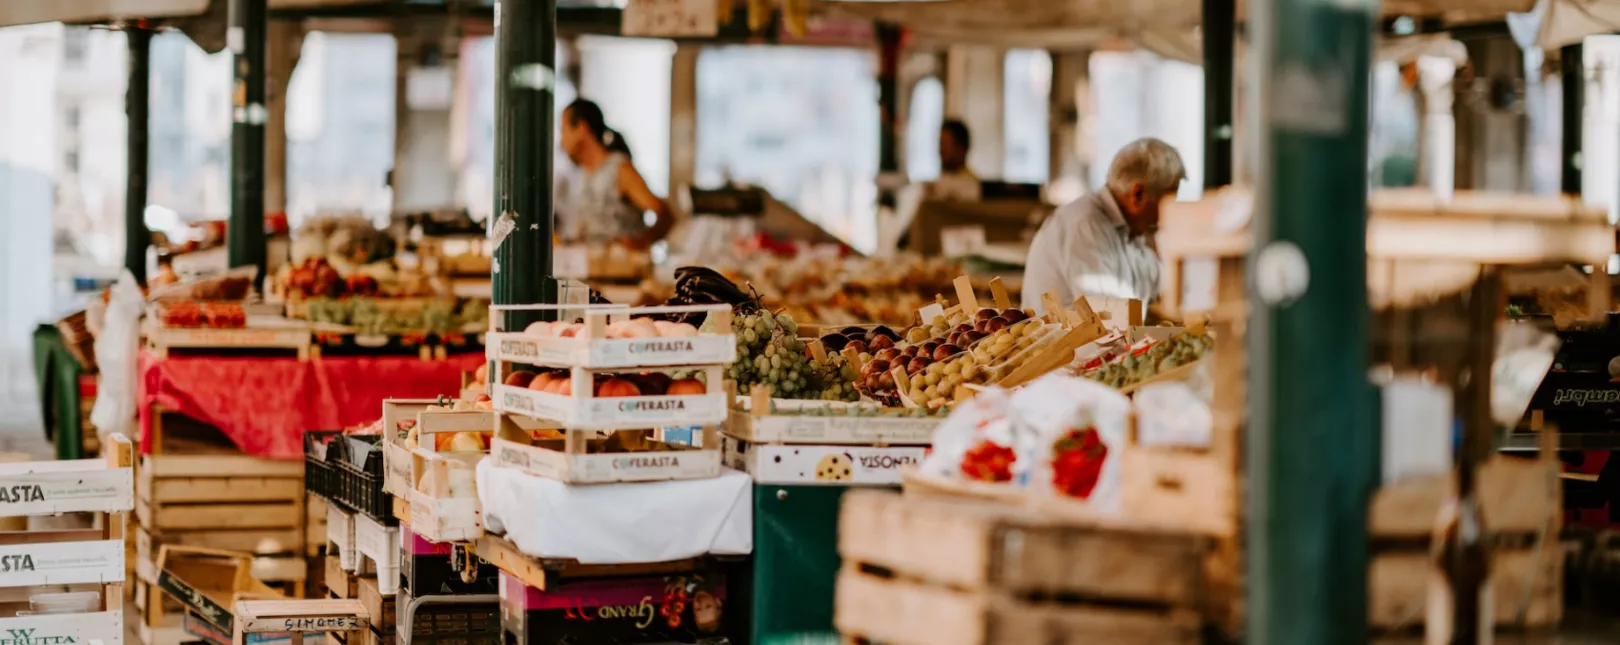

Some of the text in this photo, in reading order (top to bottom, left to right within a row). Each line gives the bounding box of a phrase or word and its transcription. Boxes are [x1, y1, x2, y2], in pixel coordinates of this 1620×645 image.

[628, 341, 694, 354] COFERASTA
[618, 400, 686, 411] COFERASTA
[1553, 389, 1620, 407] embri
[612, 457, 679, 469] COFERASTA
[0, 484, 45, 503] ASTA
[0, 554, 35, 572] STA
